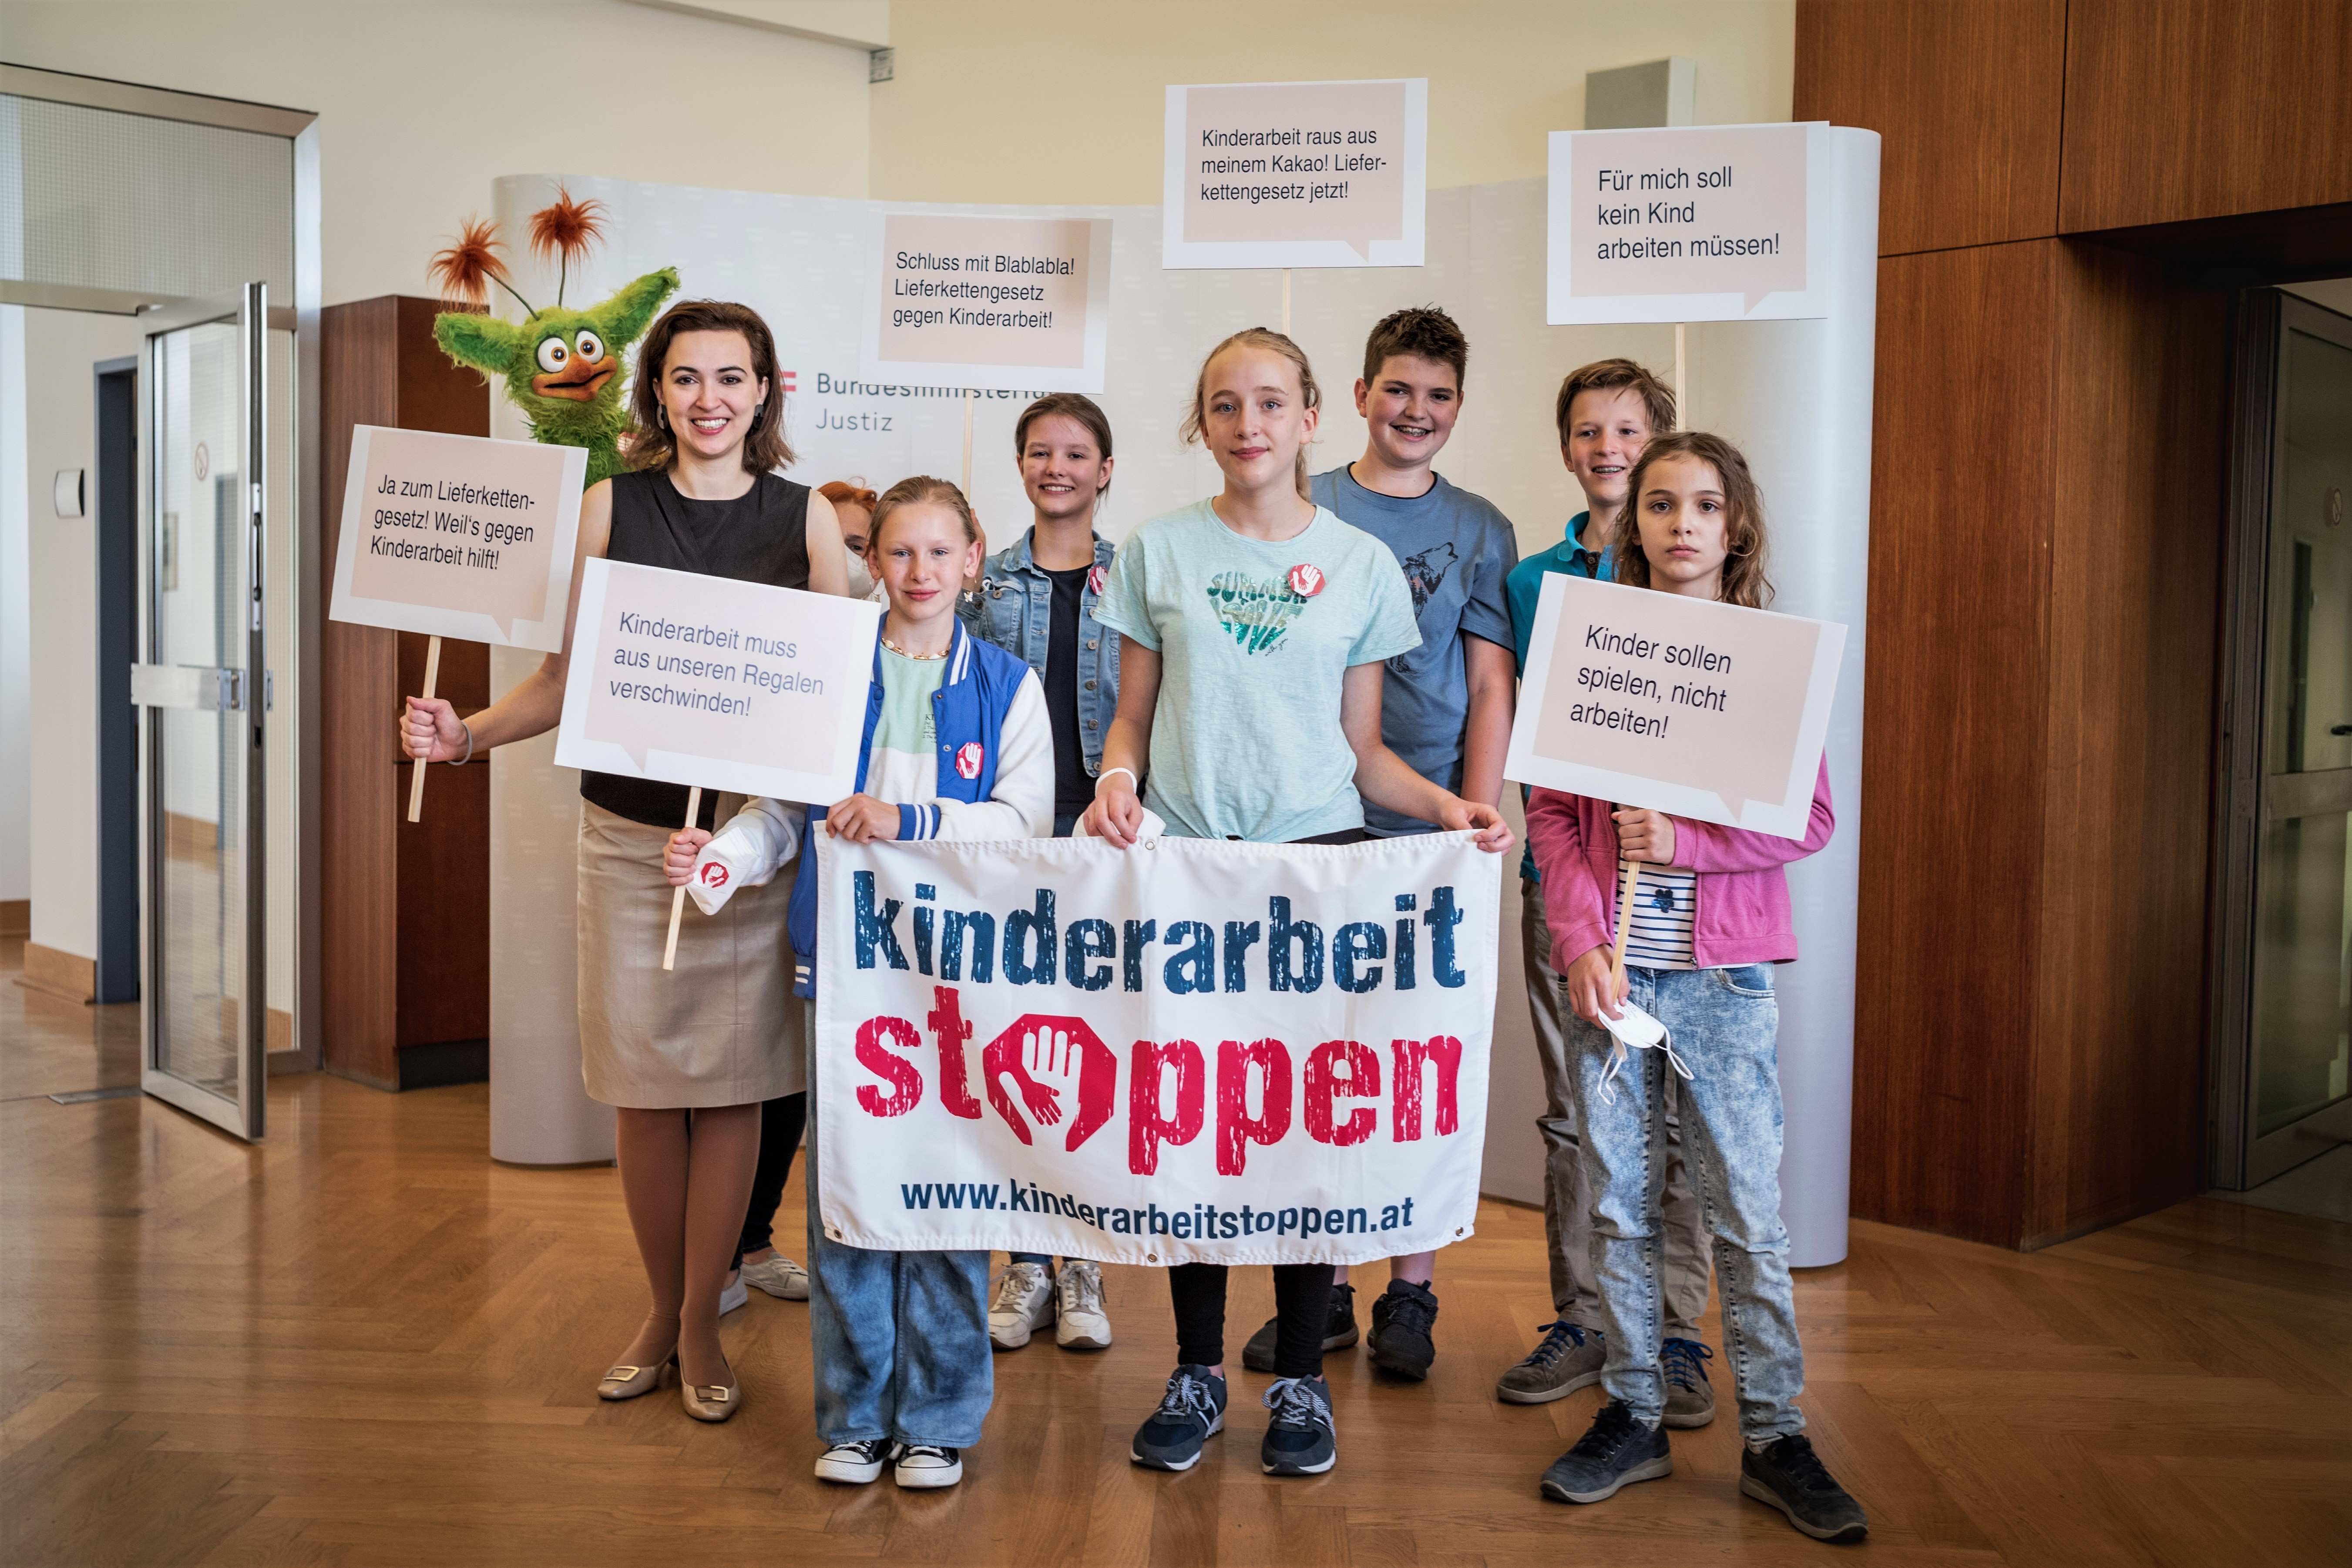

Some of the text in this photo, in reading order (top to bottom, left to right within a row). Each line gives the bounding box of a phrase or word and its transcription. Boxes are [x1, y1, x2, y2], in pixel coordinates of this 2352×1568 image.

[1203, 128, 1377, 147] Kinderarbeit raus aus
[1202, 153, 1386, 173] meinem Kakao! Liefer-
[1599, 166, 1731, 191] Für mich soll
[1201, 181, 1348, 204] kettengesetz jetzt!
[1599, 201, 1694, 225] kein Kind
[896, 252, 1074, 275] Schluss mit Blablabla!
[1598, 233, 1779, 259] arbeiten müssen!
[895, 279, 1044, 304] Lieferkettengesetz
[893, 307, 1052, 328] gegen Kinderarbeit!
[816, 408, 892, 431] Justiz
[378, 474, 534, 510] Ja zum Lieferketten-
[374, 509, 429, 529] gesetz!
[484, 522, 533, 545] gegen
[371, 535, 499, 570] Kinderarbeit hilft!
[619, 611, 796, 658] Kinderarbeit muss
[1586, 625, 1731, 674] Kinder sollen
[614, 649, 823, 695] aus unseren Regalen
[1578, 667, 1727, 712] spielen, nicht
[610, 681, 751, 716] verschwinden!
[1570, 702, 1669, 739] arbeiten!
[854, 870, 1465, 994] kinderarbeit
[901, 1178, 1414, 1239] www.kinderarbeitstoppen.at
